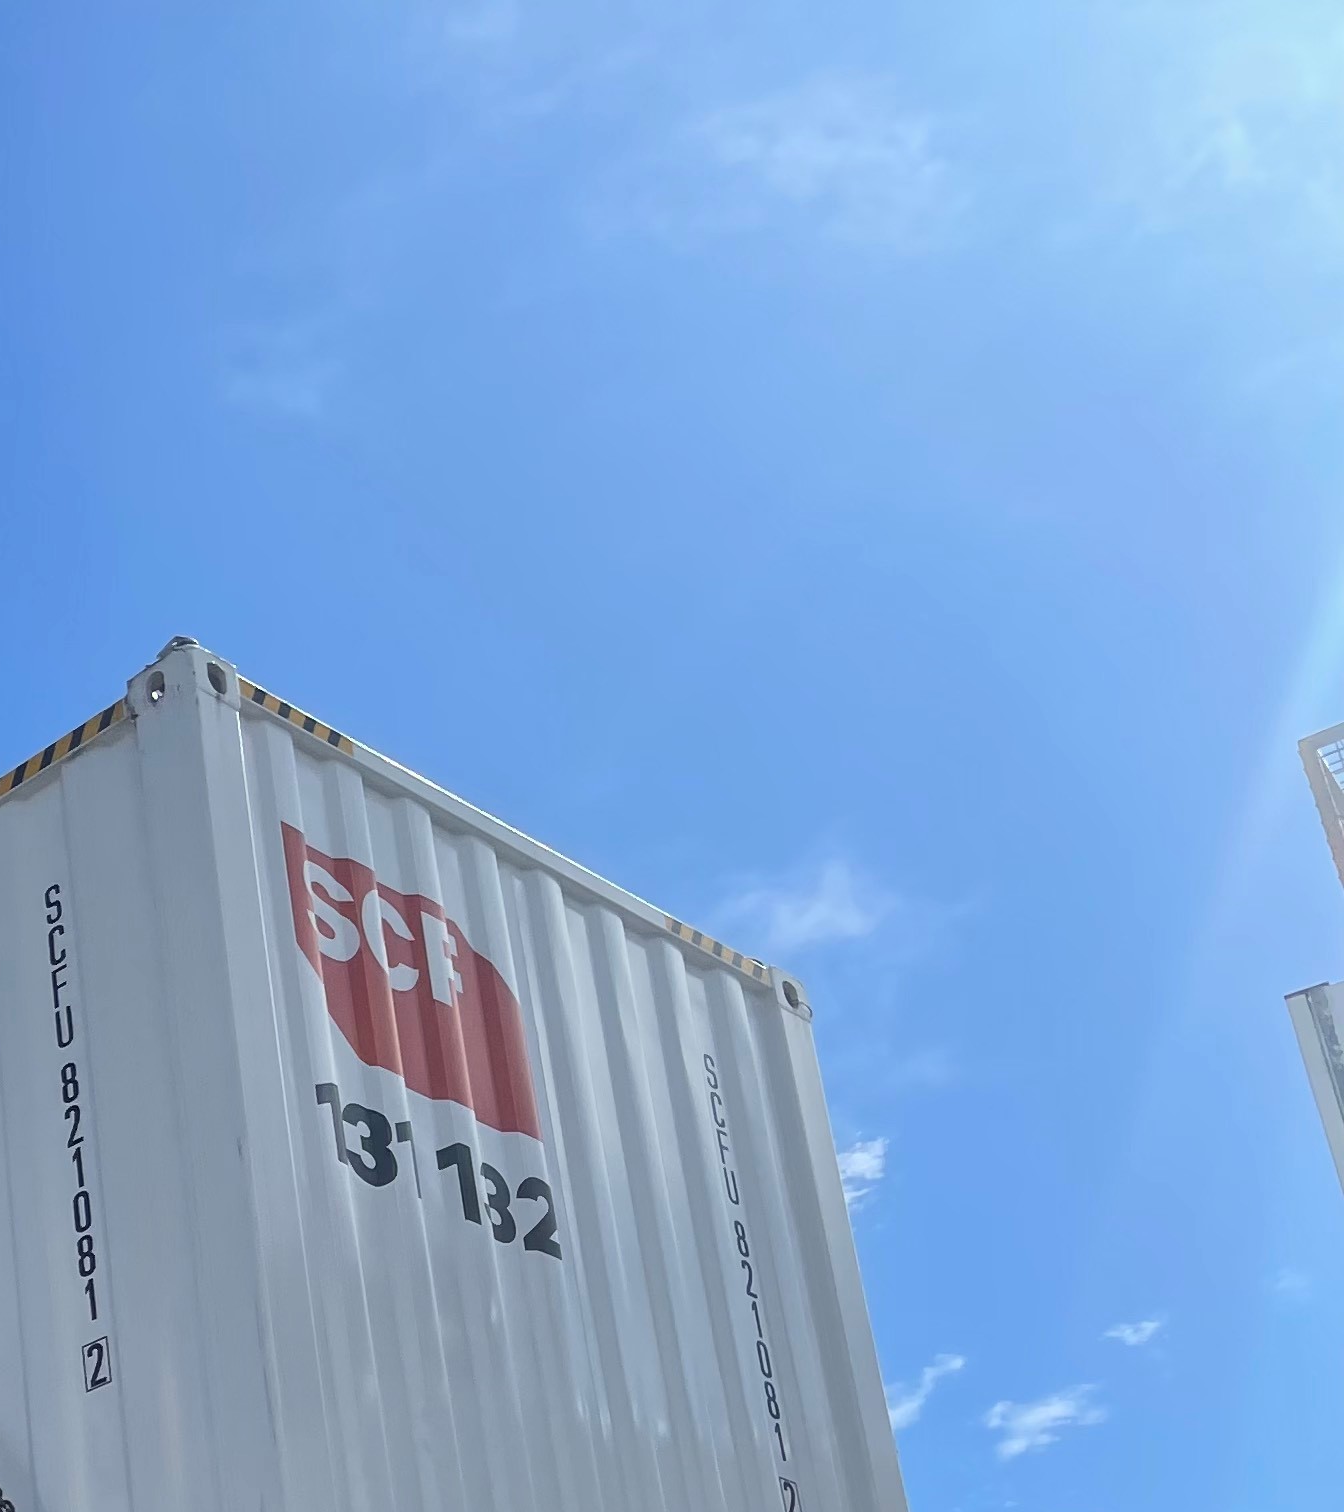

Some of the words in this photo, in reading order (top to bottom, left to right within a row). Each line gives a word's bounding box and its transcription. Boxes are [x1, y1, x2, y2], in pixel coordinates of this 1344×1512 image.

[303, 860, 464, 1008] SCF
[45, 883, 75, 1049] SCFU
[61, 1062, 98, 1321] 821081
[84, 1339, 110, 1389] 2
[435, 1142, 563, 1261] 132
[703, 1054, 740, 1206] SCFU
[737, 1219, 786, 1462] 821081
